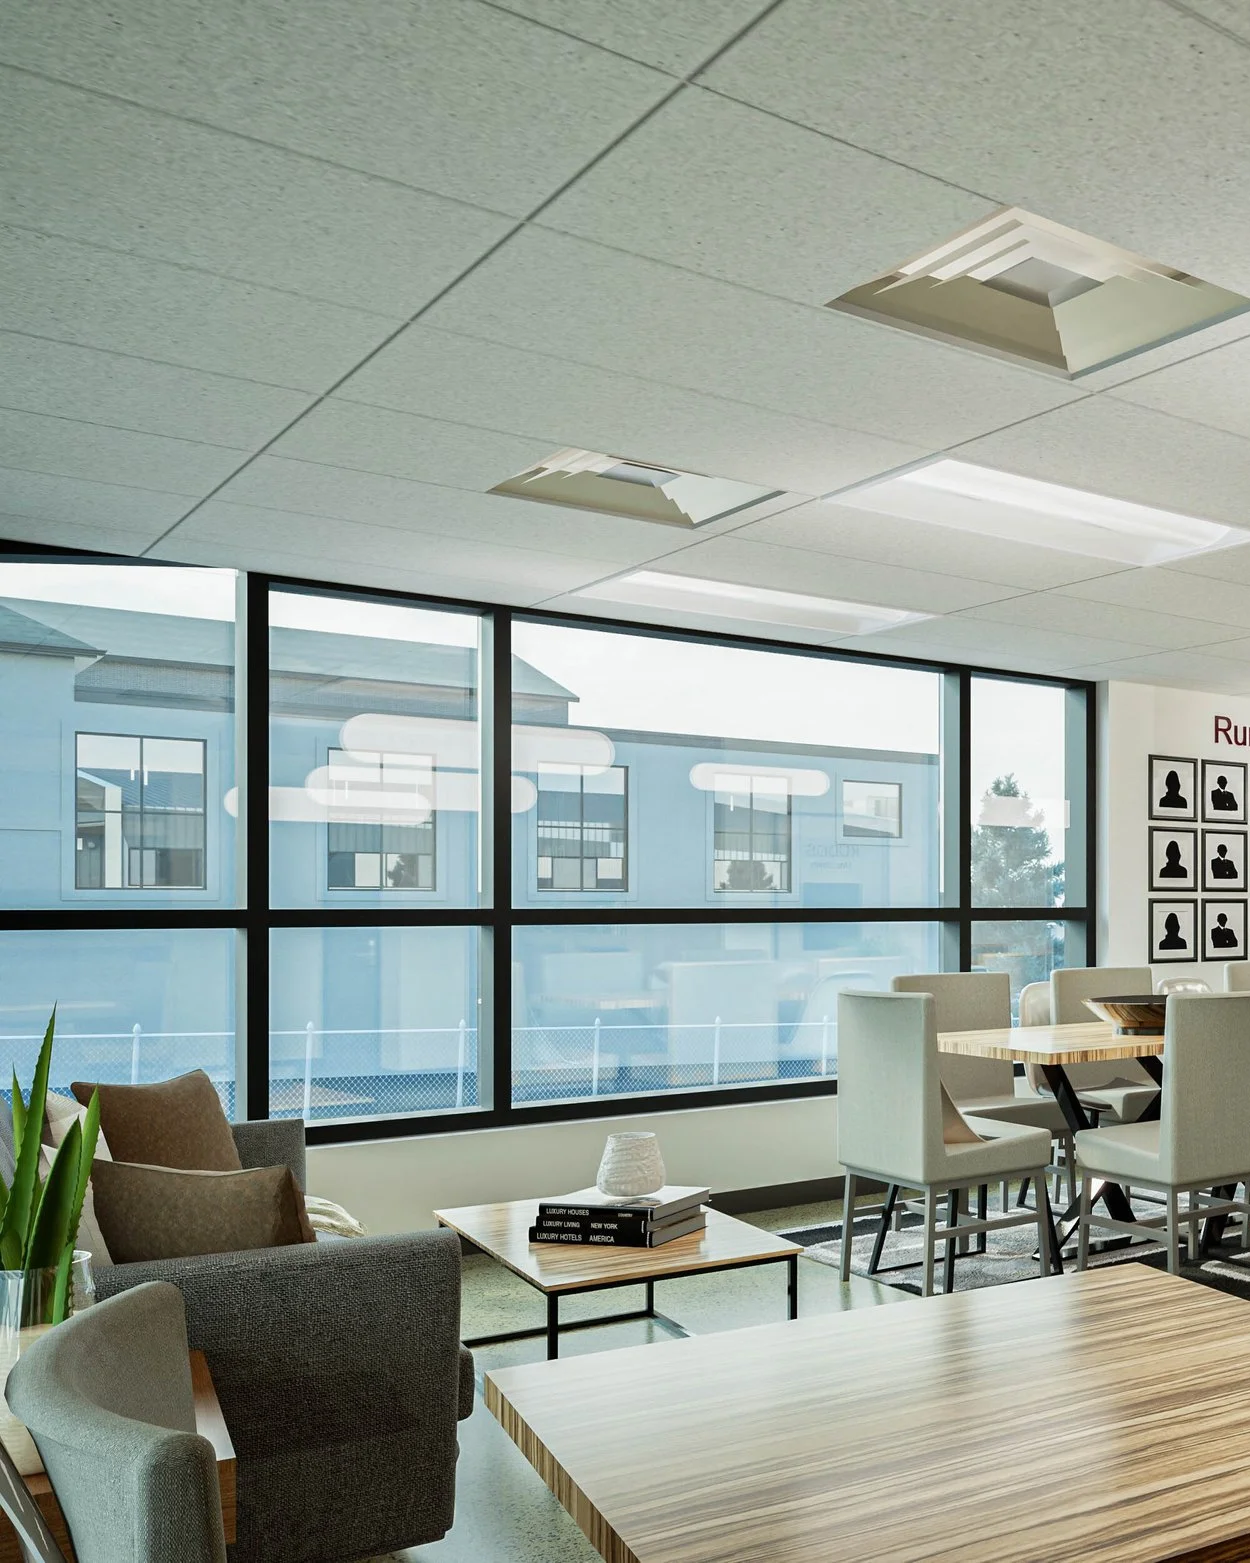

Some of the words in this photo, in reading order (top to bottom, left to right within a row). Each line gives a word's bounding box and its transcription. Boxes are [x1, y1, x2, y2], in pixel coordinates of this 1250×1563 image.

[604, 1222, 618, 1230] YORK
[560, 1234, 582, 1242] HOTELS
[589, 1235, 615, 1243] AMERICA
